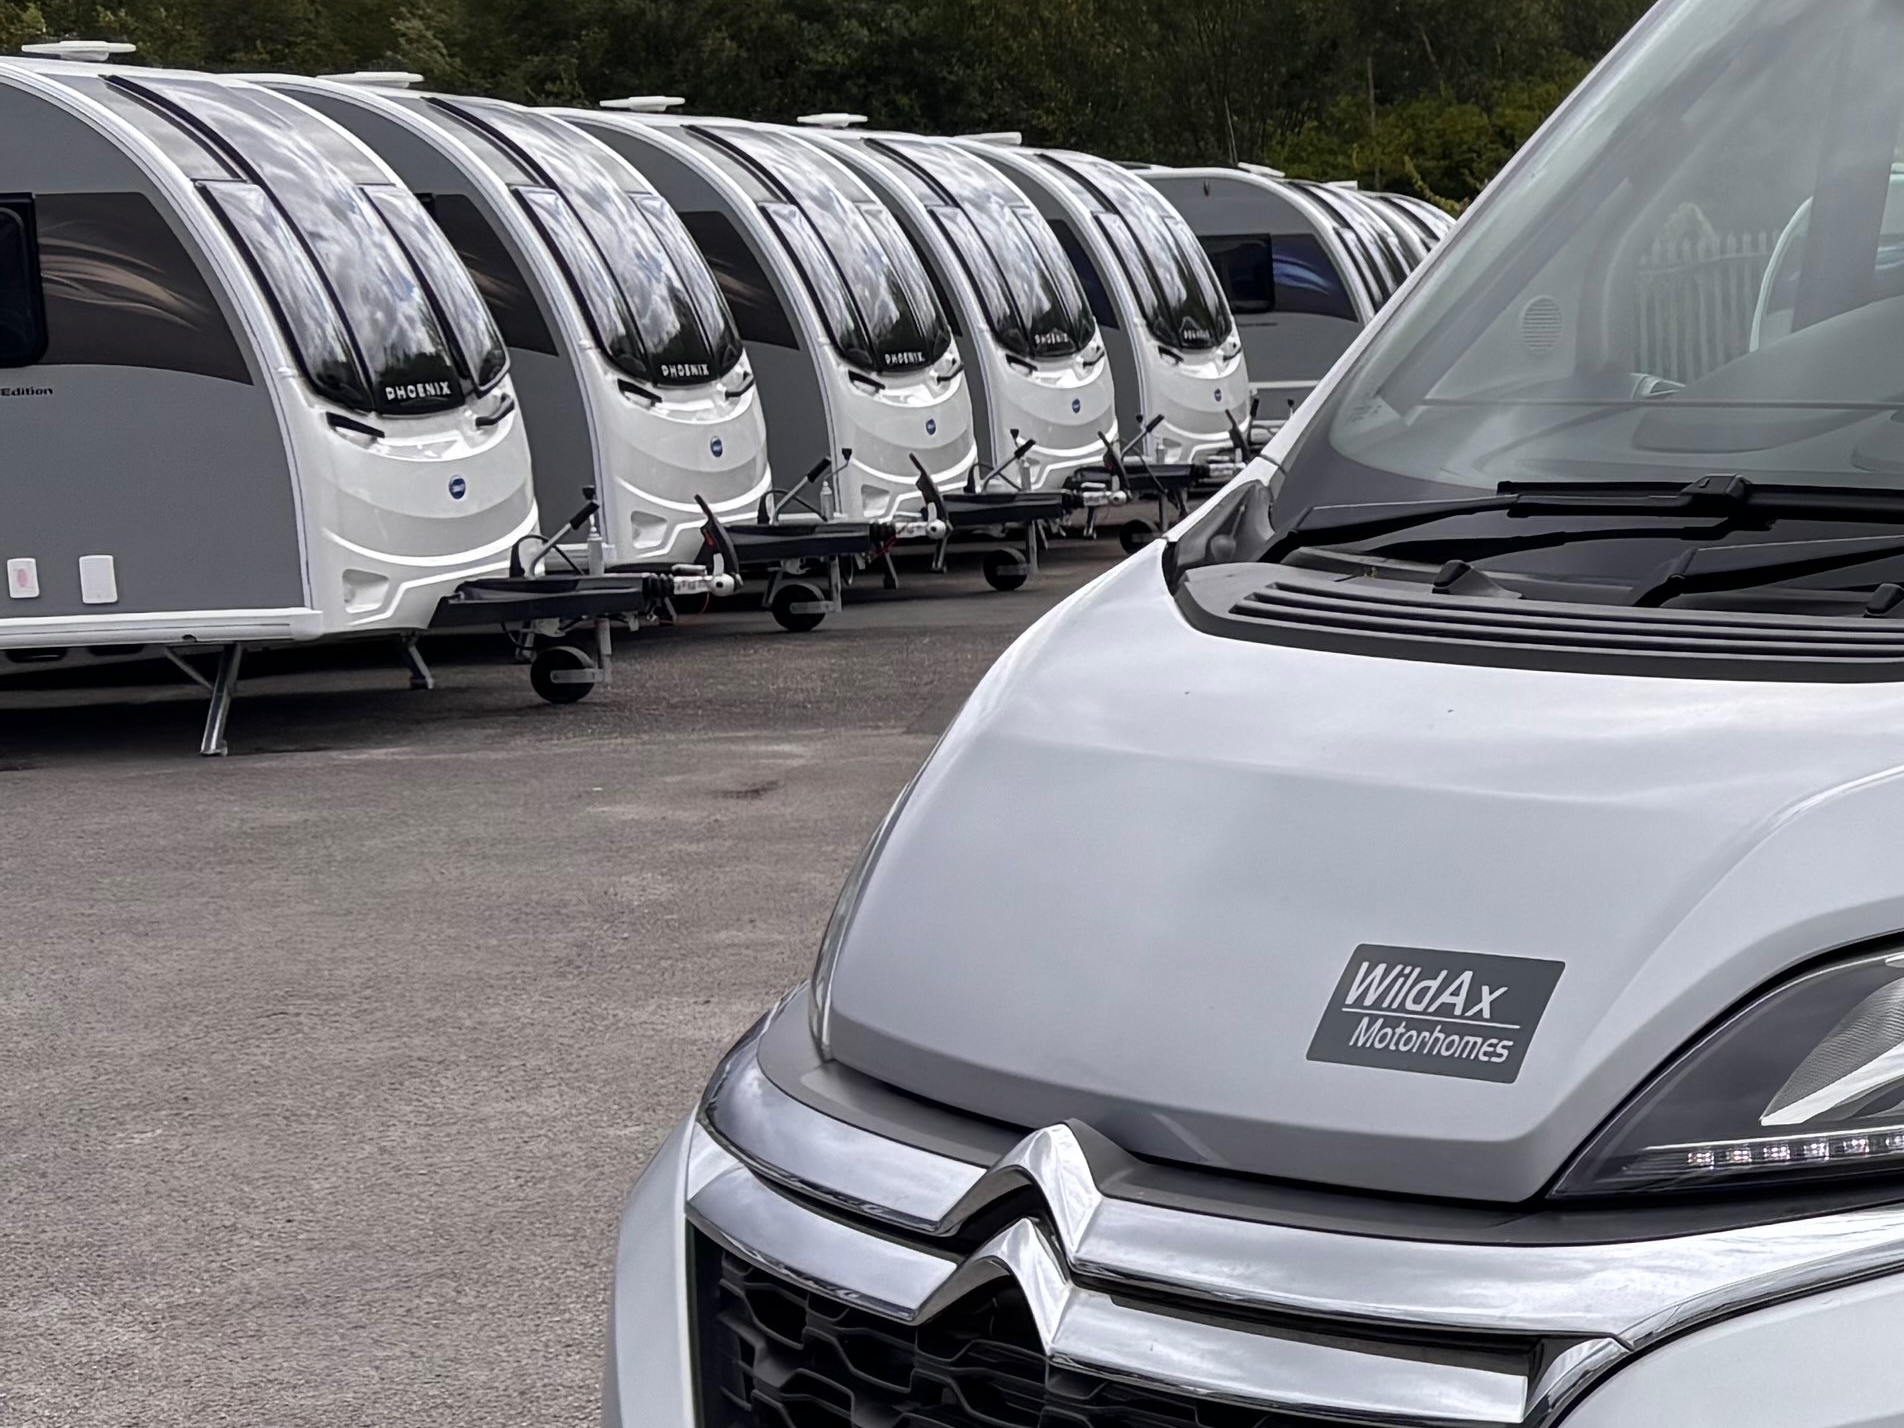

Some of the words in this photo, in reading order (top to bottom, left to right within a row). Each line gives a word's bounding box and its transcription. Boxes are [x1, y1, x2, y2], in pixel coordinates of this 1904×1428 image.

[661, 362, 710, 378] PHOENIX
[0, 386, 54, 397] Edition
[385, 380, 452, 401] PHOENIX
[1345, 961, 1509, 1019] WildAx
[1349, 1016, 1514, 1063] Motorhomes
